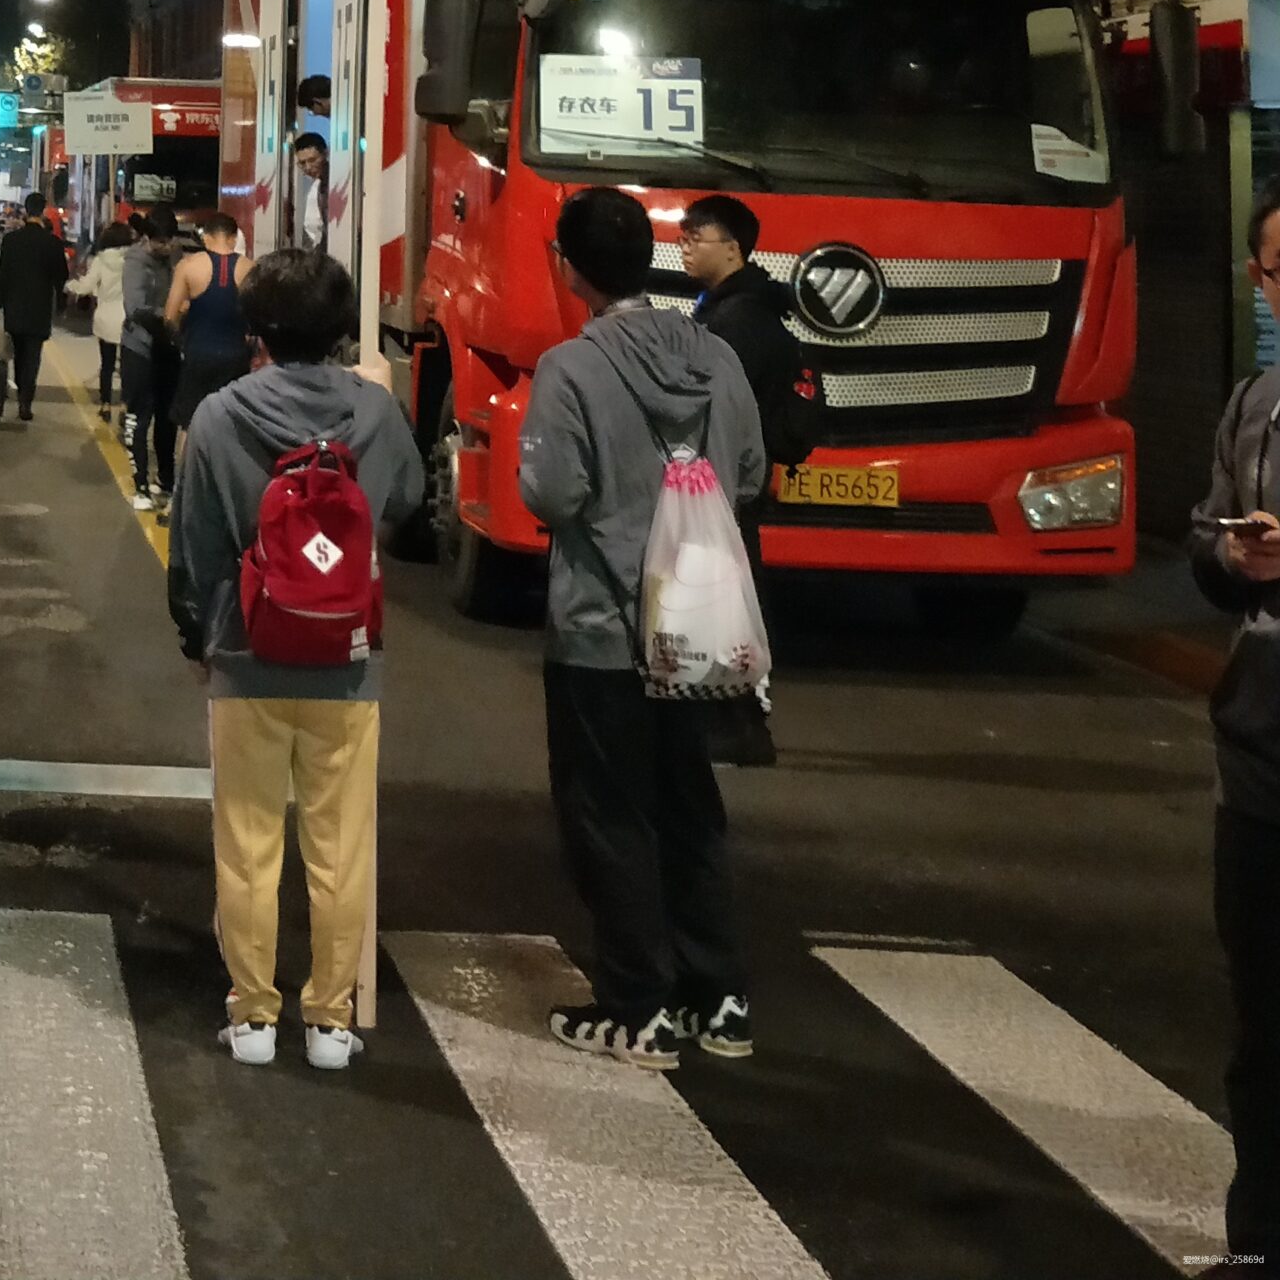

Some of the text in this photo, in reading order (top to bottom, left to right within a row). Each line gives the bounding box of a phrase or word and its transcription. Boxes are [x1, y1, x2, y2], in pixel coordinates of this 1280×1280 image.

[558, 95, 618, 115] 存衣车
[636, 87, 695, 132] 15
